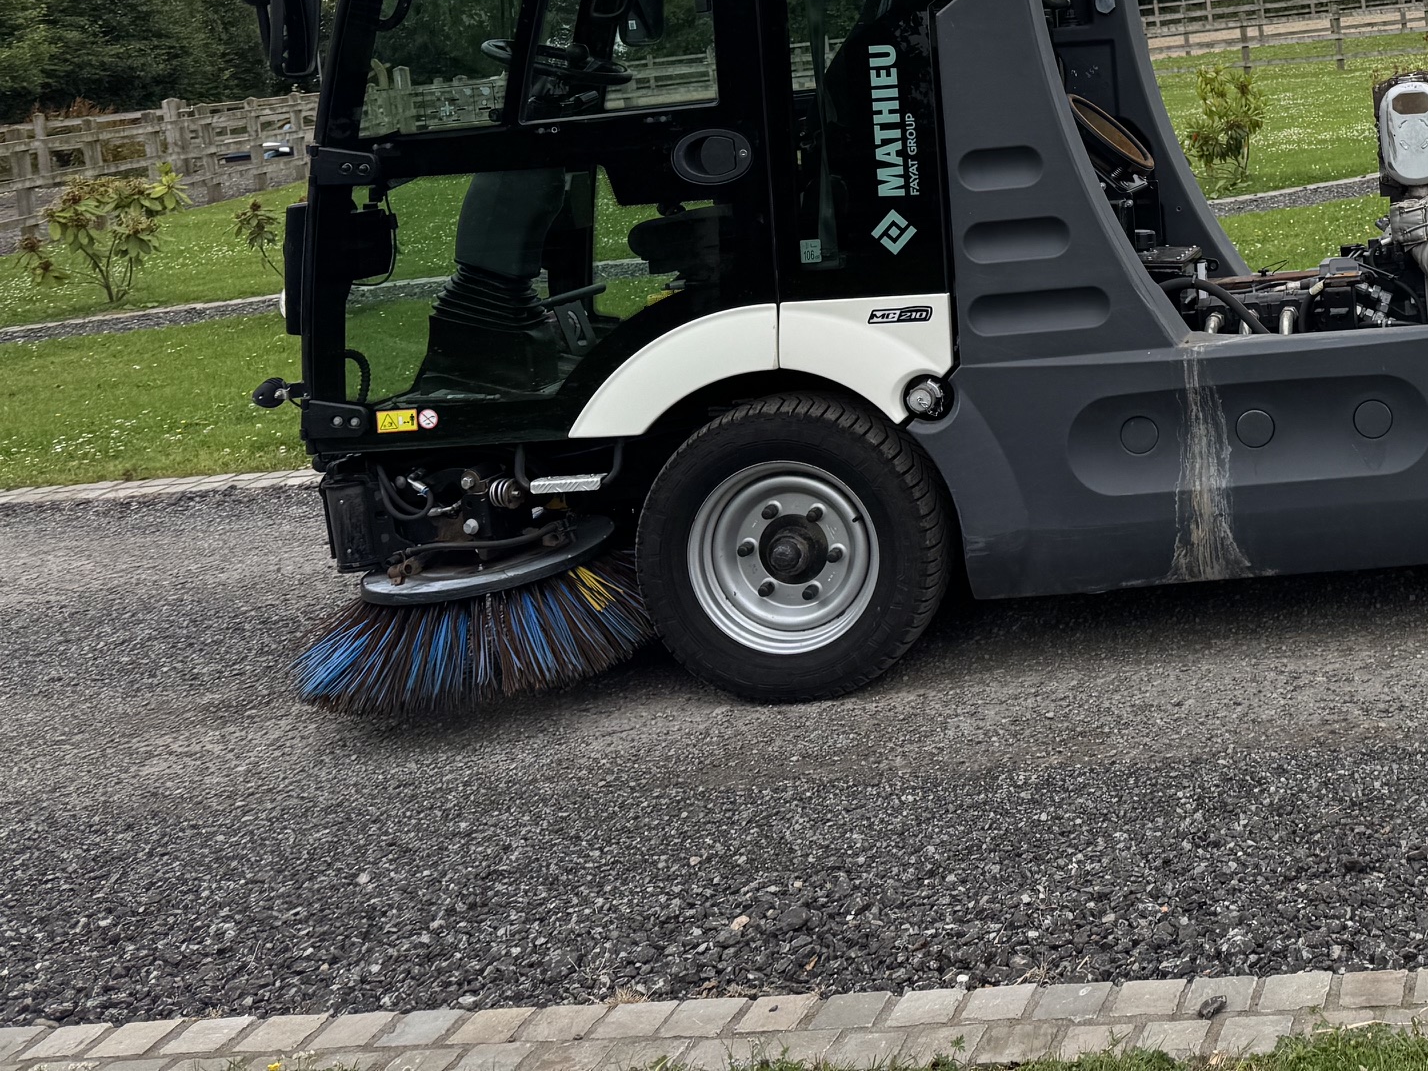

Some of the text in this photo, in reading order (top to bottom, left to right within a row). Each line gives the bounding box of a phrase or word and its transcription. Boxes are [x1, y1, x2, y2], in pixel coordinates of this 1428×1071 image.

[868, 44, 906, 197] MATHIEU
[905, 112, 920, 196] FAYAT GROUP
[803, 250, 815, 261] 106
[870, 311, 927, 320] MC 210
